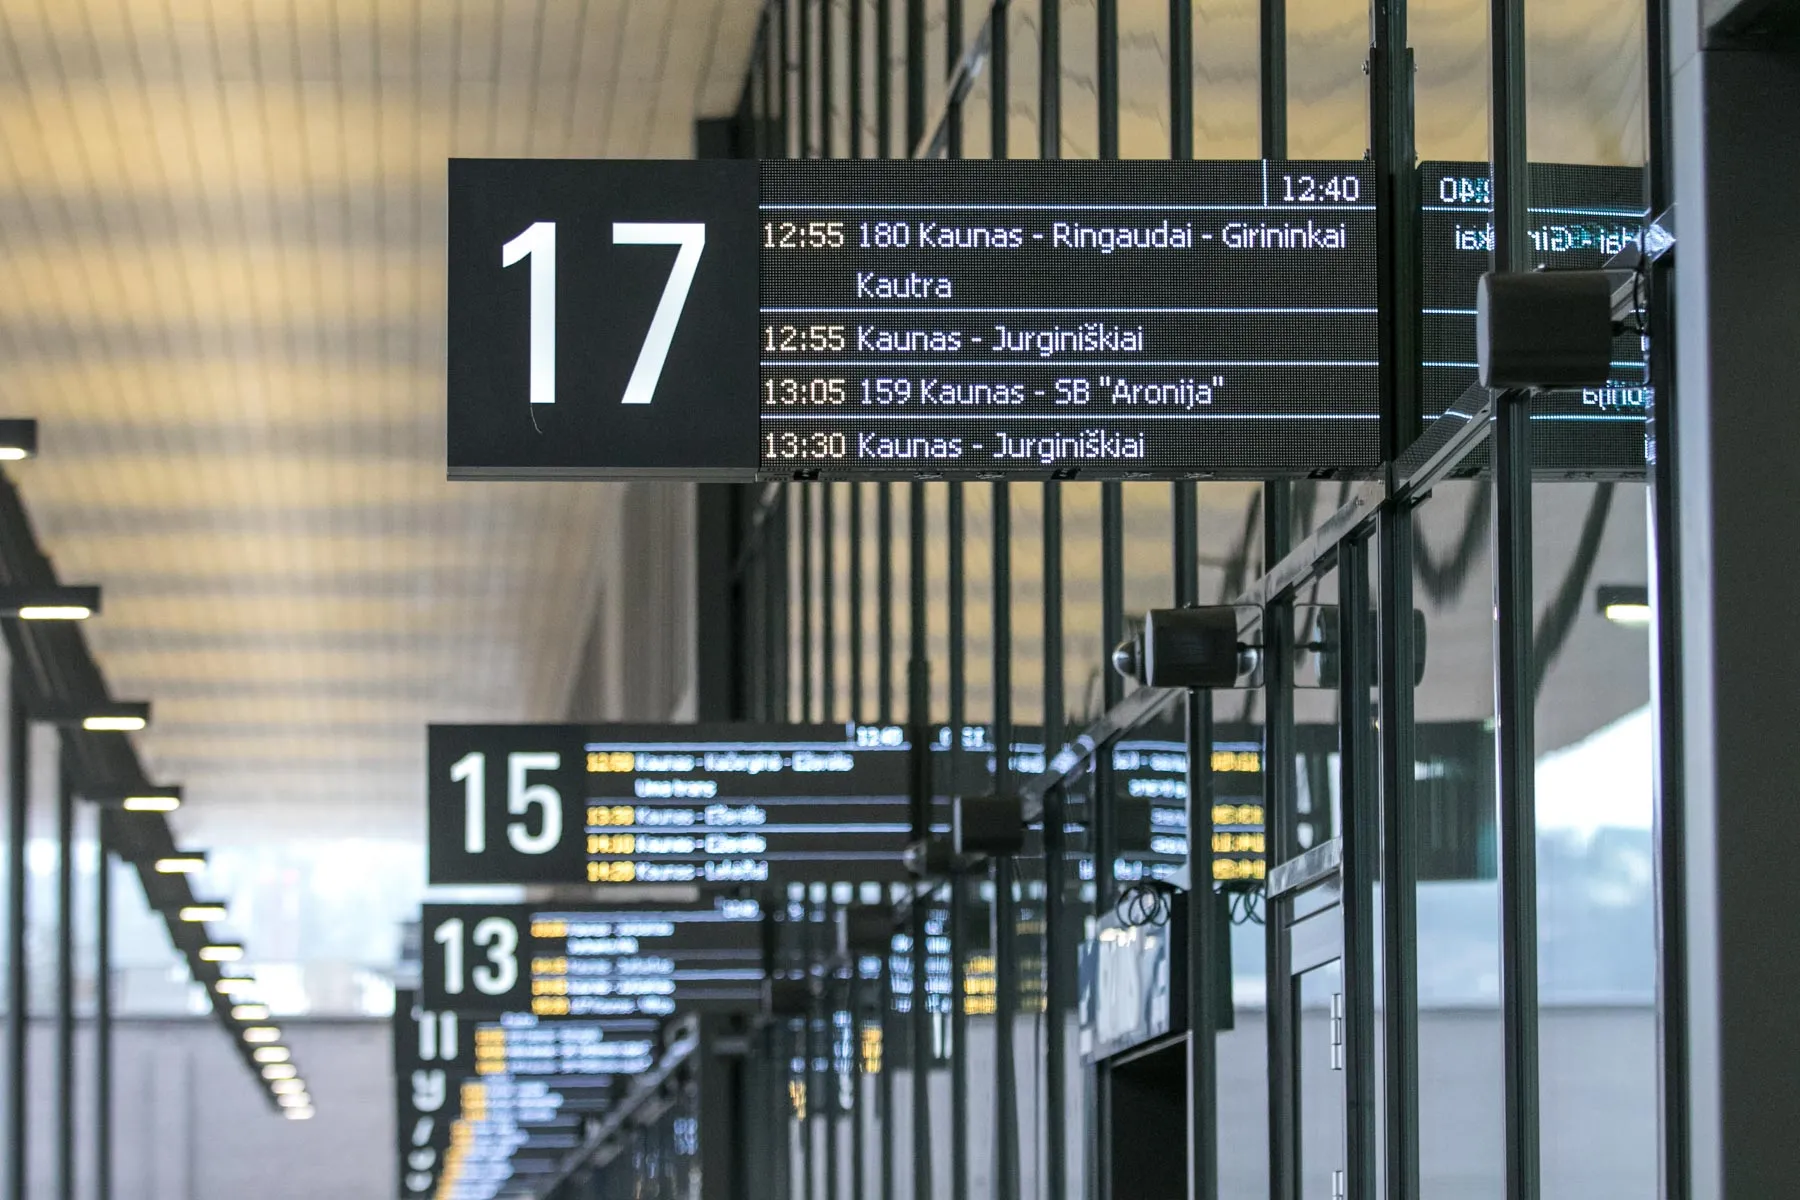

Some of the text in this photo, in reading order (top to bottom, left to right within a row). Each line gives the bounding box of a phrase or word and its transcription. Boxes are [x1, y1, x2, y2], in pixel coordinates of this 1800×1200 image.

[1282, 174, 1360, 203] 12:40
[764, 221, 845, 249] 12:55
[859, 221, 910, 249] 180
[918, 221, 1023, 249] Kaunas
[1053, 219, 1192, 255] Ringaudai
[1221, 219, 1347, 249] Girininkai
[856, 271, 953, 298] Kautra
[501, 221, 707, 405] 17
[765, 325, 846, 352] 12:55
[857, 325, 962, 352] Kaunas
[992, 322, 1144, 358] Jurginiškiai
[765, 378, 846, 406] 13:05
[860, 378, 913, 406] 159
[920, 378, 1025, 406] Kaunas
[1054, 378, 1090, 406] SB
[1098, 375, 1225, 412] "Aronija"
[766, 431, 846, 459] 13:30
[858, 431, 963, 459] Kaunas
[992, 428, 1146, 465] Jurginiškiai
[450, 751, 562, 855] 15
[434, 917, 519, 996] 13
